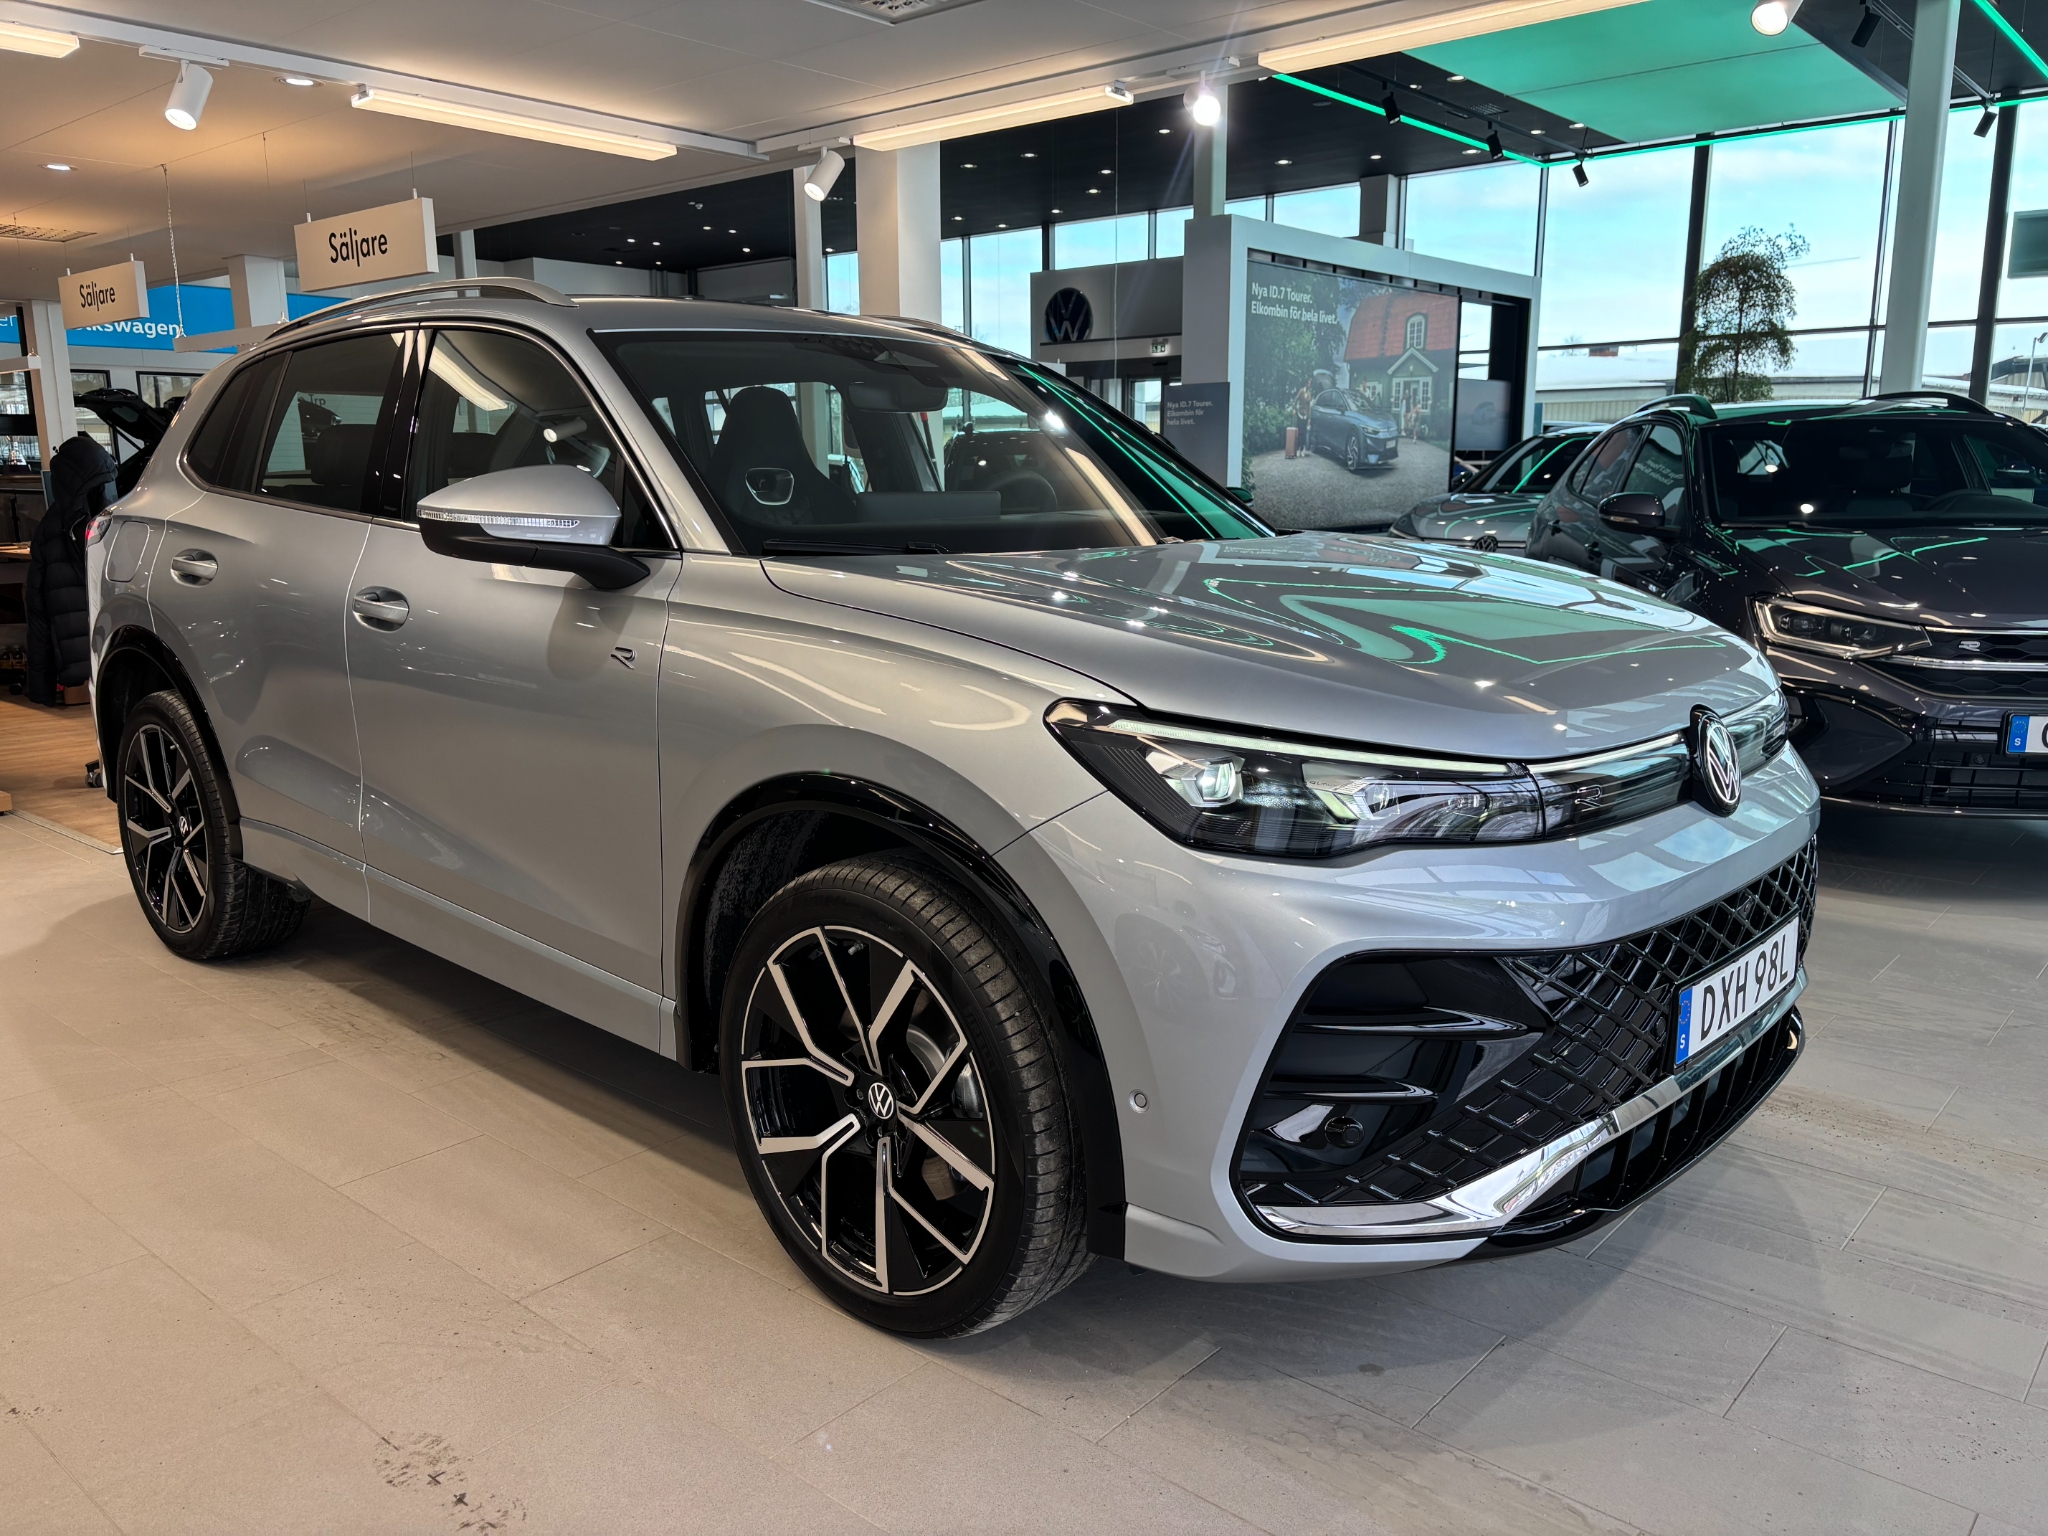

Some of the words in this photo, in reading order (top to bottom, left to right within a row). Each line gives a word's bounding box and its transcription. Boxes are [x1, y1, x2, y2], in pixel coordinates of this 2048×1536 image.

[328, 227, 388, 267] Säljare
[79, 281, 116, 312] Säljare
[1251, 282, 1268, 299] Nya
[1269, 285, 1285, 299] ID.7
[1286, 287, 1313, 304] Tourer.
[1251, 301, 1288, 319] Elkombin
[1290, 305, 1302, 320] för
[1302, 308, 1318, 322] hela
[1319, 310, 1338, 325] livet.
[1167, 401, 1179, 409] Nya
[2014, 737, 2022, 747] S
[1700, 960, 1749, 1042] DXH
[1754, 933, 1788, 1004] 98L
[1679, 1033, 1686, 1050] S
